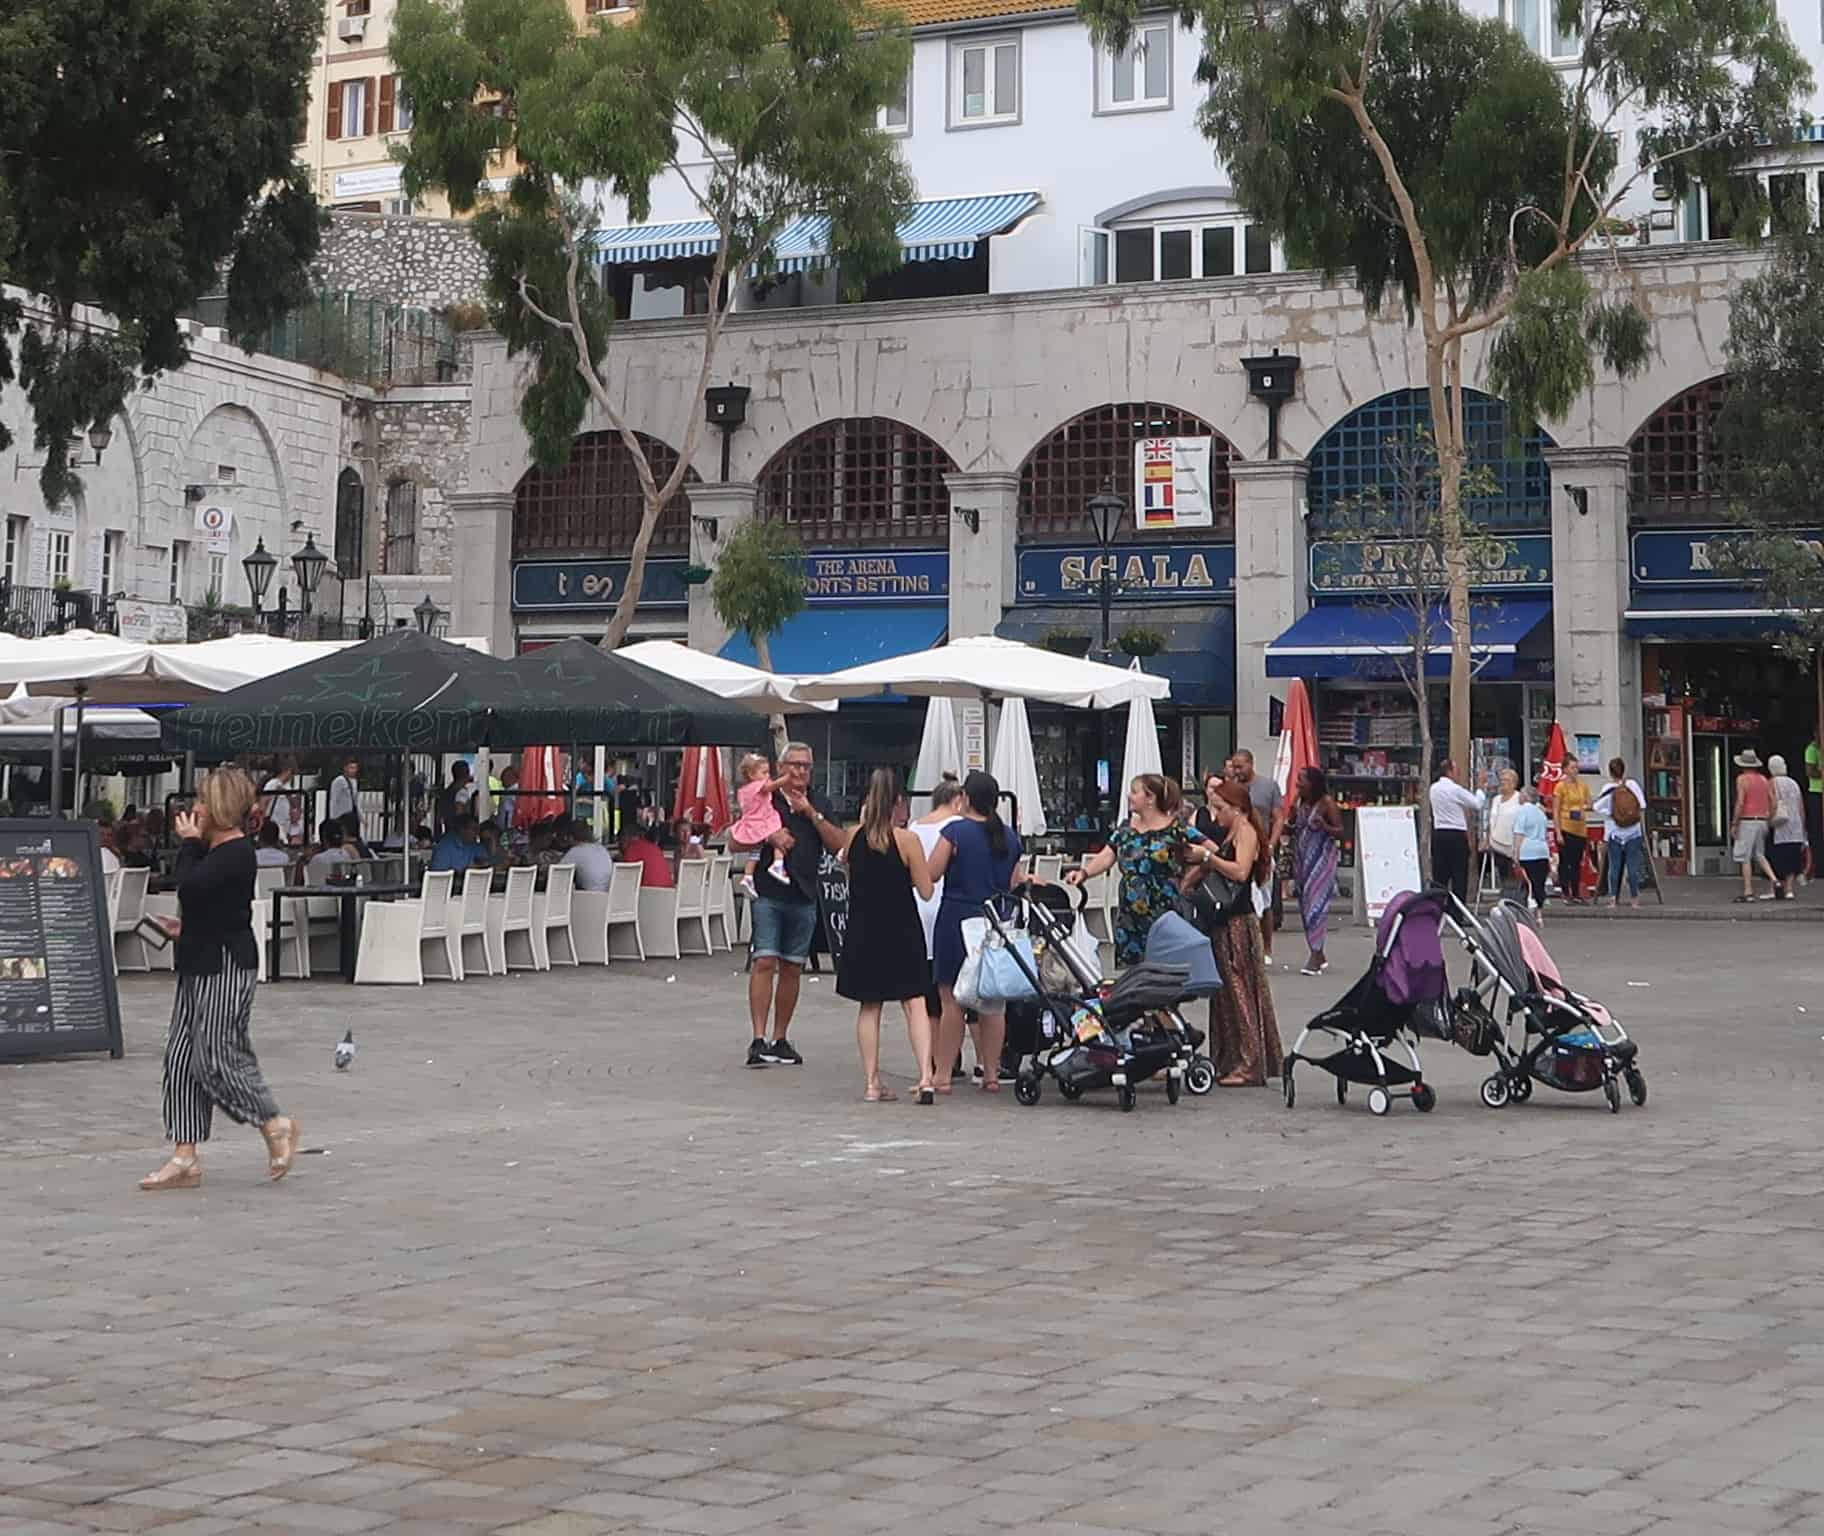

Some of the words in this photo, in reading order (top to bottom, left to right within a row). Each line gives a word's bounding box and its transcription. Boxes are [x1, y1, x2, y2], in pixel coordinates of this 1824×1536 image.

[815, 559, 845, 576] THE
[847, 558, 898, 575] ARENA
[1059, 553, 1214, 590] SCALA
[800, 576, 853, 594] PORTS
[856, 575, 930, 593] BETTING
[176, 704, 475, 749] Heineken
[822, 880, 850, 902] FISH
